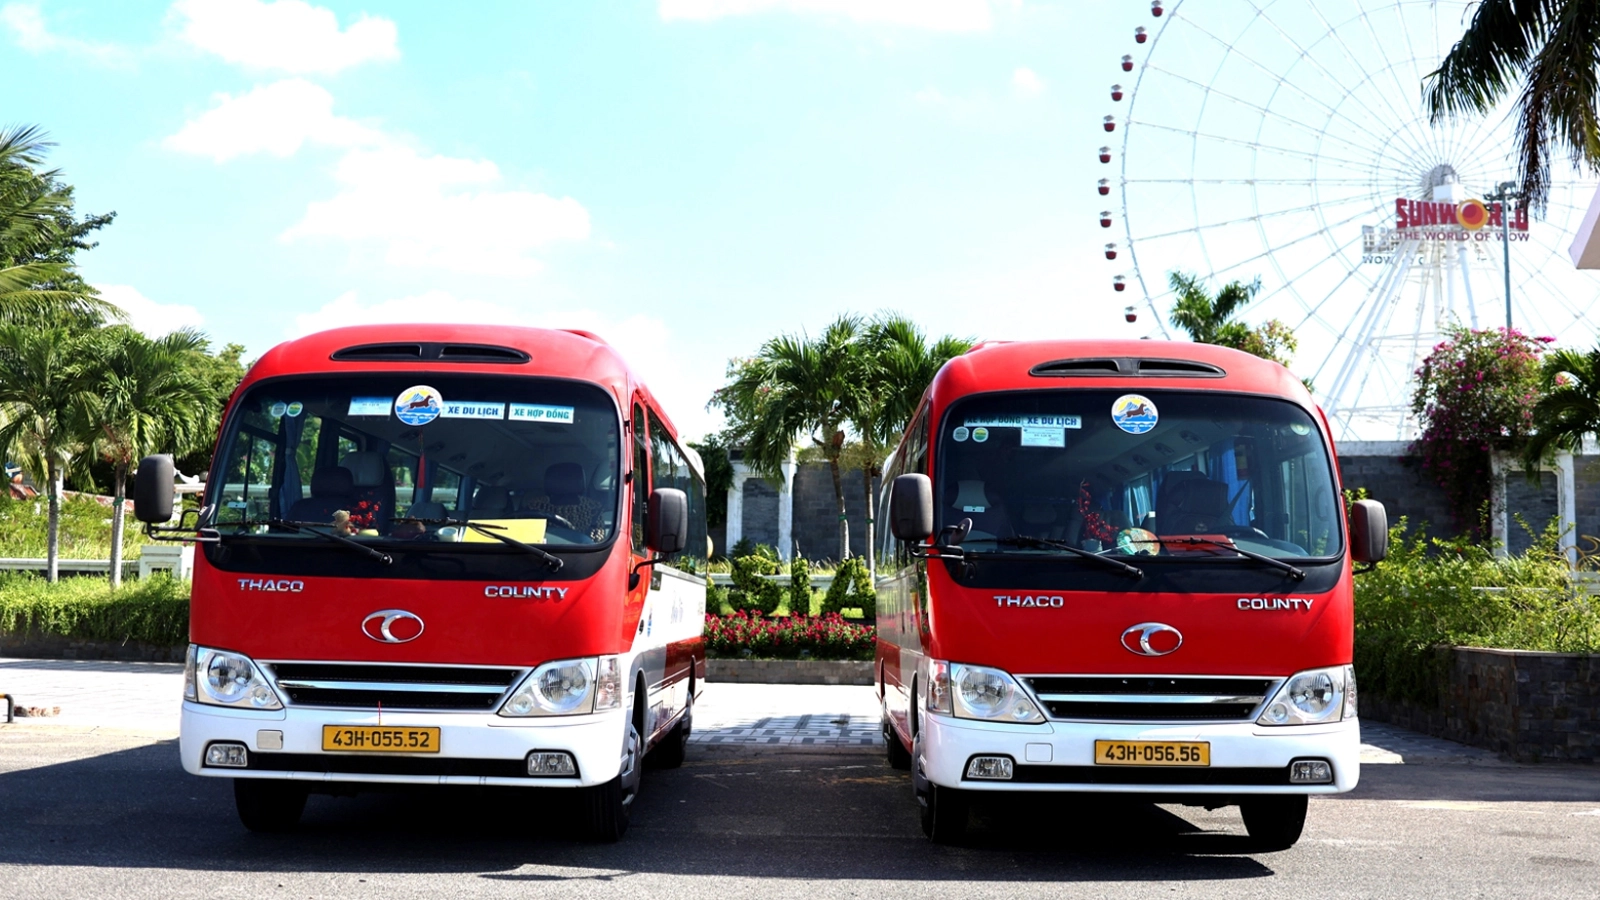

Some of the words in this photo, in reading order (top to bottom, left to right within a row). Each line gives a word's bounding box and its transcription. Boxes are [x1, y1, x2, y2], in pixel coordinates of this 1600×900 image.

[1398, 231, 1420, 241] THE
[1425, 231, 1470, 242] WORLD
[1474, 232, 1491, 242] OF
[447, 406, 460, 415] XE
[513, 408, 525, 416] XE
[1027, 415, 1039, 425] XE
[237, 578, 305, 593] THACO
[484, 585, 570, 599] COUNTY
[993, 595, 1065, 609] THACO
[1237, 597, 1314, 611] COUNTY
[332, 729, 431, 749] 43H-055.52
[1104, 744, 1201, 763] 43H-056.56
